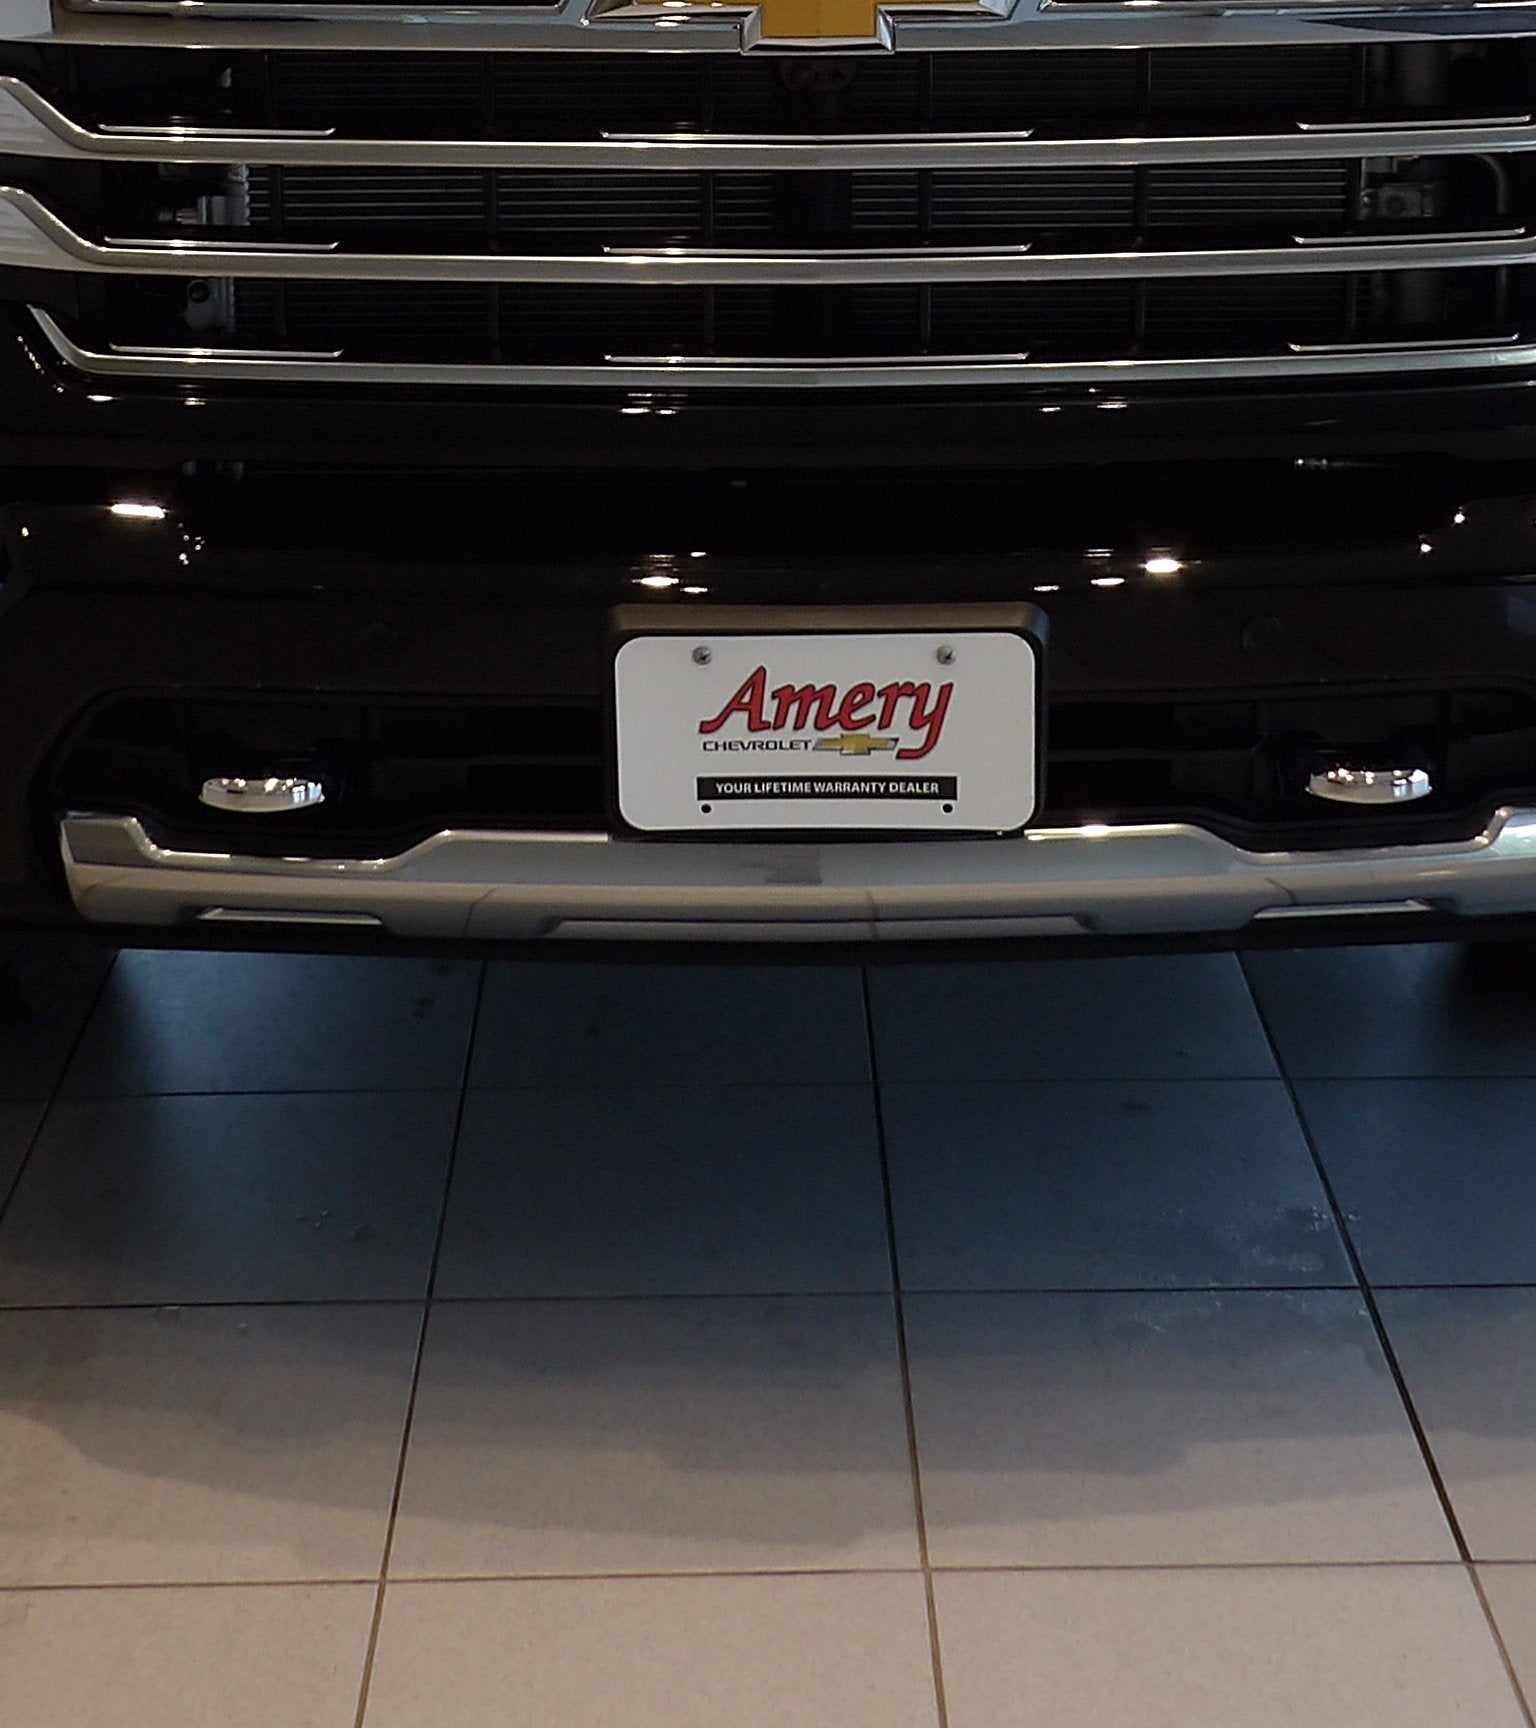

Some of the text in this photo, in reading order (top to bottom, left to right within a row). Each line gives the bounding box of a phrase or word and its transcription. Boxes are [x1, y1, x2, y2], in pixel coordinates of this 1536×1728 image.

[698, 665, 954, 760] Amery
[702, 739, 812, 752] CHEVROLET
[716, 782, 939, 794] YOUR LIFETIME WARRANTY DEALER
